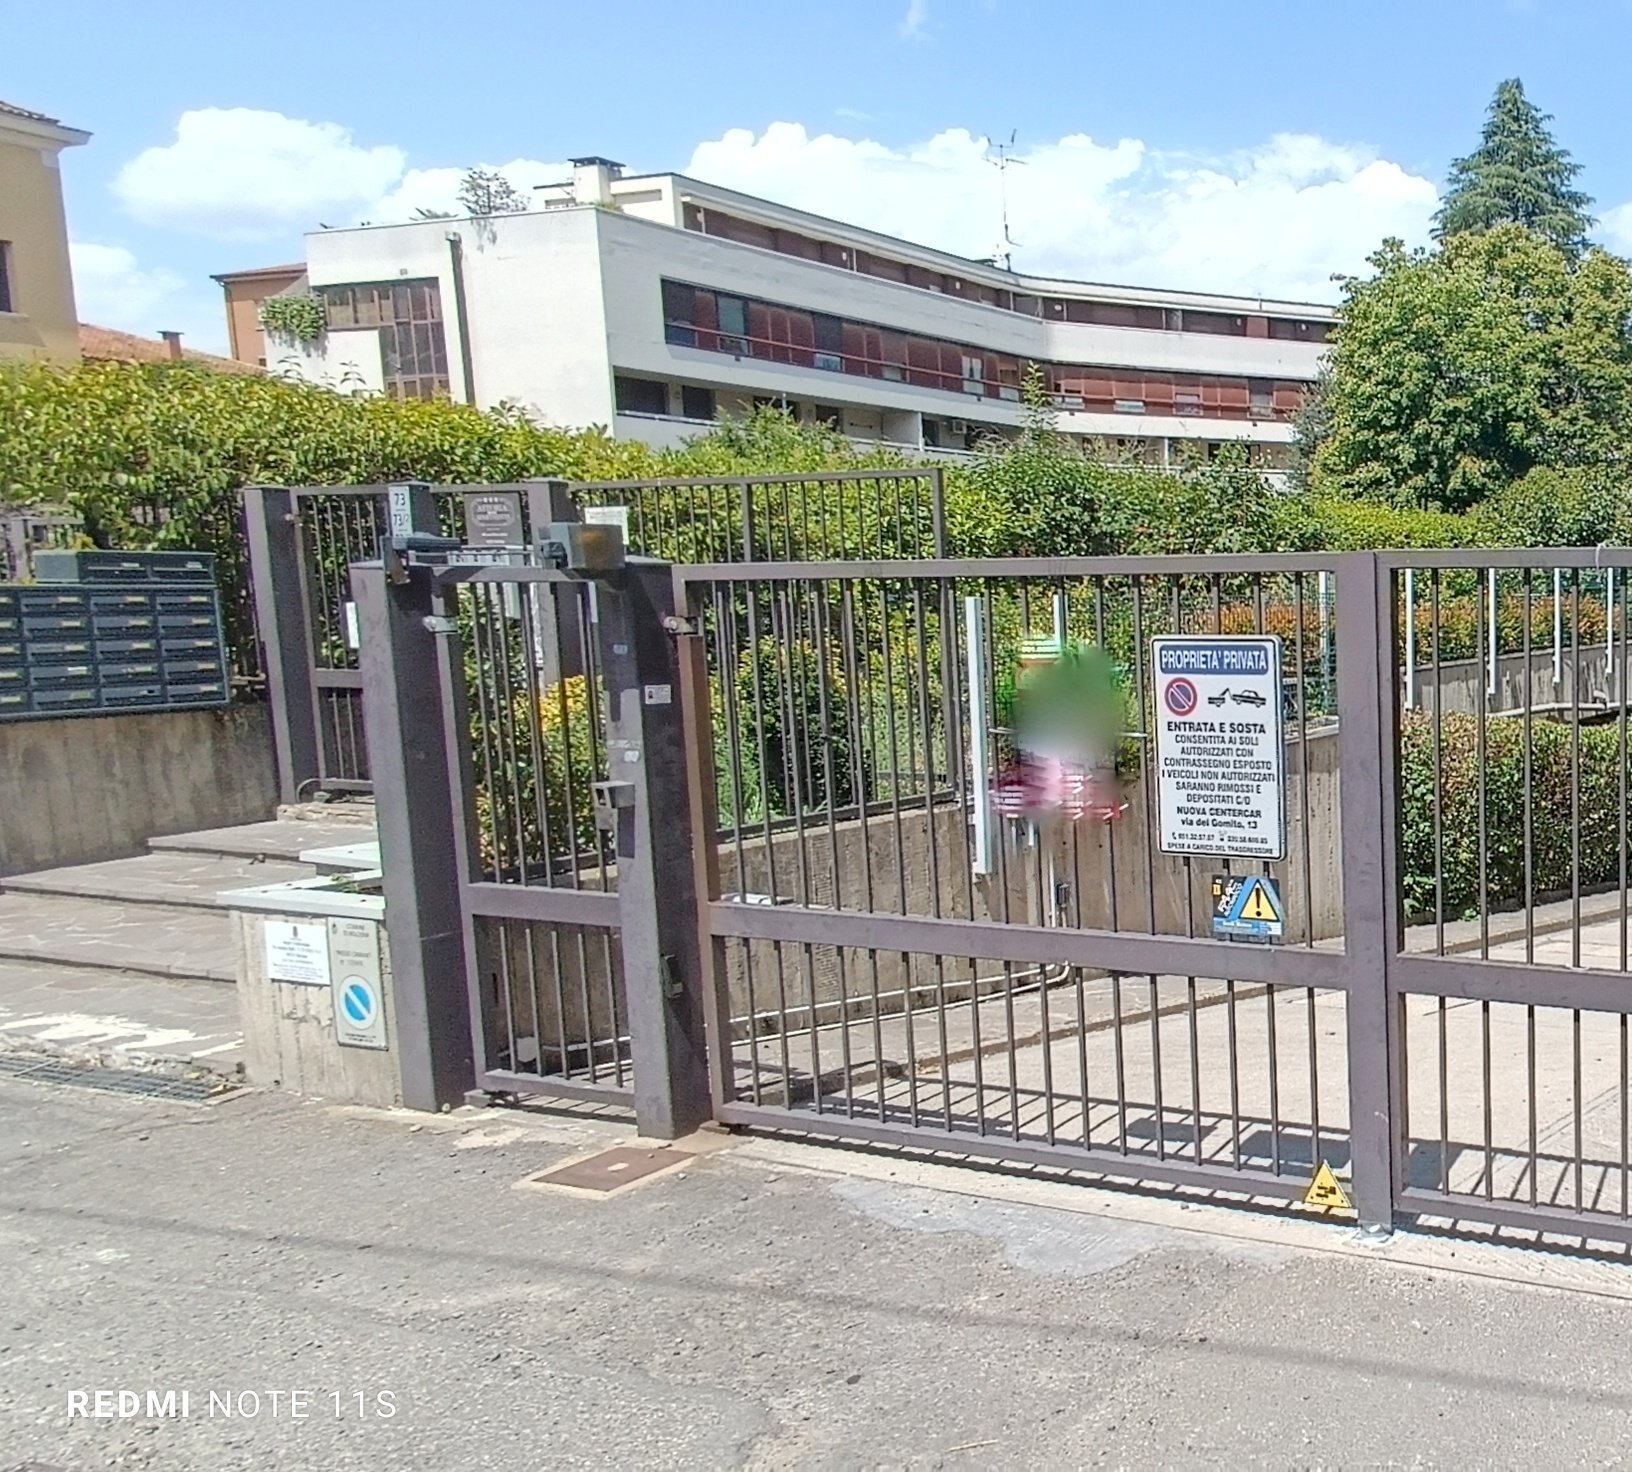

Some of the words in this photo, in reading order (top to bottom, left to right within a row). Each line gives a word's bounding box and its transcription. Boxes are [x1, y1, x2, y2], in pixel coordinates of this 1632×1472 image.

[394, 492, 406, 506] 73
[1161, 649, 1221, 669] PROPRIETA'
[1223, 650, 1267, 670] PRIVATA
[1167, 721, 1216, 733] ENTRATA
[1219, 722, 1226, 733] E
[1229, 723, 1266, 735] SOSTA
[1175, 734, 1226, 745] CONSENTITA
[1228, 735, 1237, 745] AI
[1239, 736, 1259, 746] SOLI
[1180, 746, 1234, 757] AUTORIZZATI
[1236, 748, 1254, 757] CON
[1164, 757, 1231, 769] CONTRASSEGNO
[1233, 760, 1272, 771] ESPOSTO
[1161, 769, 1165, 778] I
[1167, 769, 1199, 780] VEICOLI
[1200, 770, 1219, 780] NON
[1221, 771, 1275, 783] AUTORIZZATI
[1175, 781, 1215, 792] SARANNO
[1217, 783, 1254, 794] RIMOSSI
[1256, 784, 1262, 794] E
[1186, 793, 1234, 805] DEPOSITATI
[1176, 806, 1207, 816] NUOVA
[1209, 808, 1262, 818] CENTERCAR
